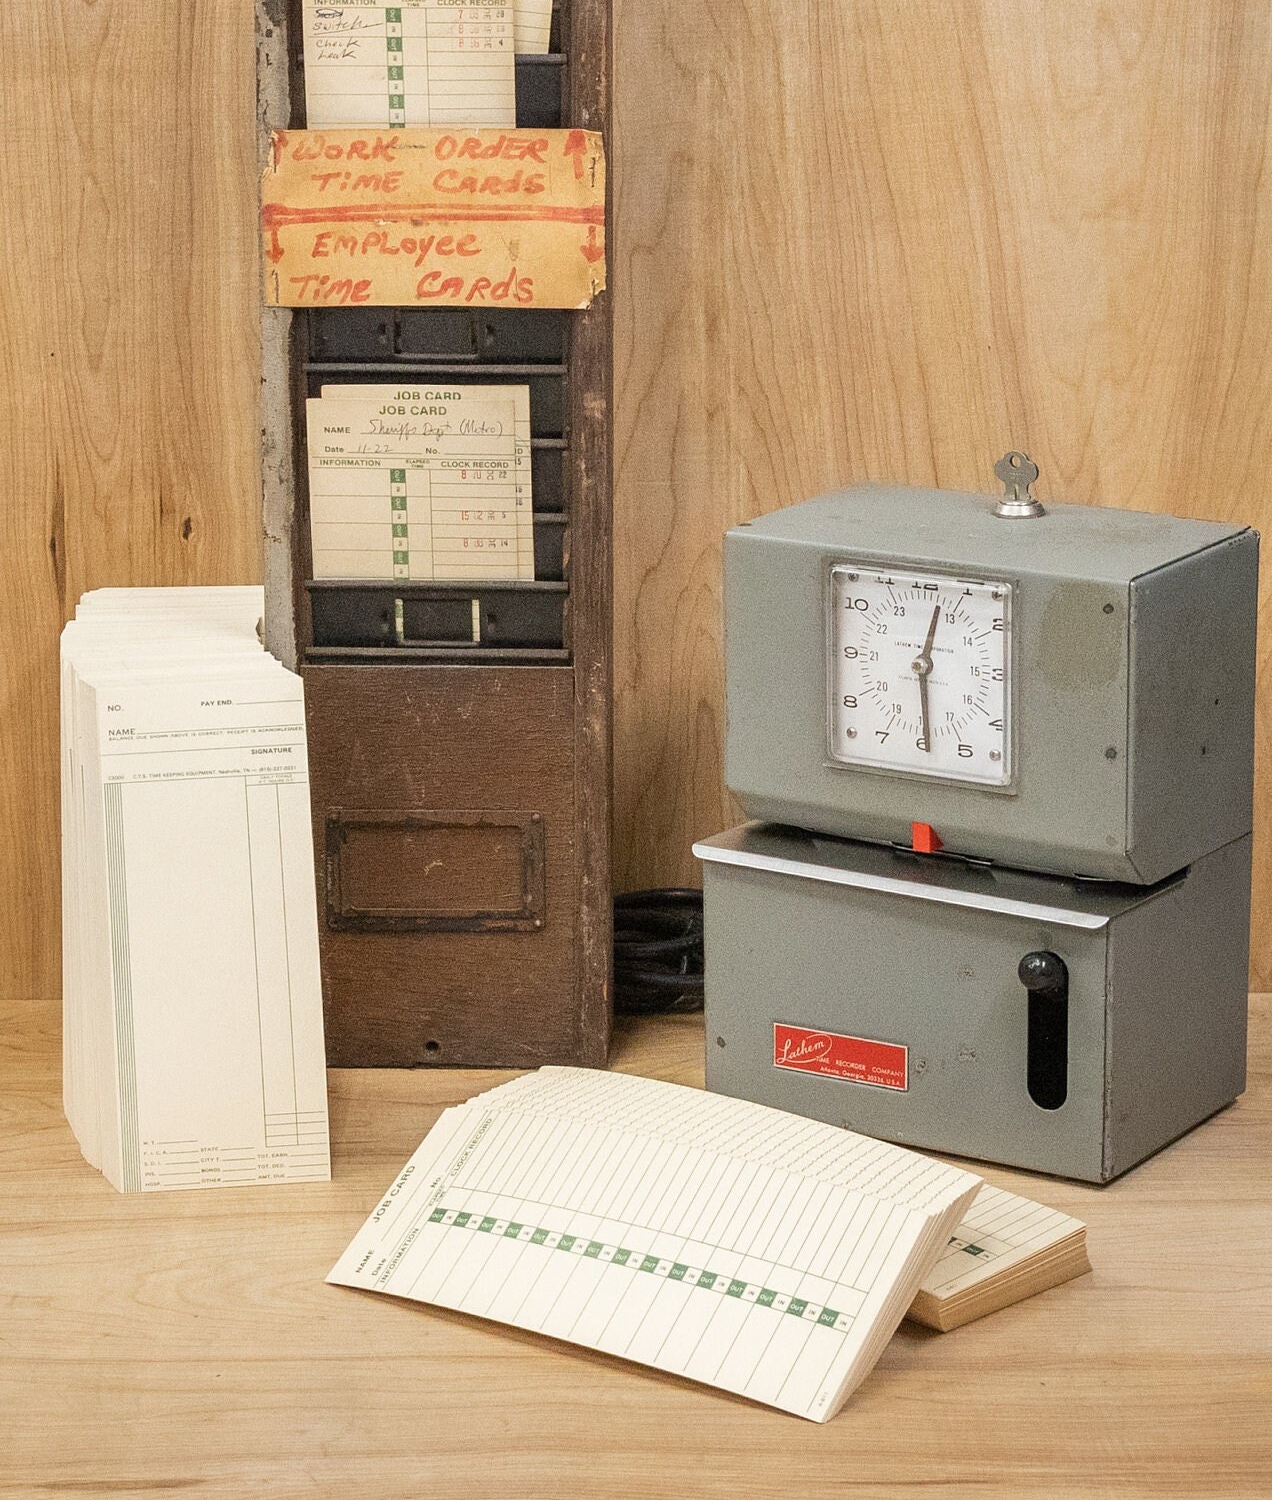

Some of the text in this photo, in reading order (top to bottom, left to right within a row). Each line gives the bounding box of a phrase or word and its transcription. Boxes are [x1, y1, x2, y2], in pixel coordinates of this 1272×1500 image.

[292, 136, 399, 162] WORK
[394, 392, 461, 400] JOB CARD
[379, 406, 447, 415] JOB CARD
[845, 597, 868, 611] 10
[894, 607, 905, 617] 23
[945, 614, 955, 624] 13
[877, 625, 888, 634] 22
[963, 636, 973, 647] 14
[845, 646, 858, 658] 9
[870, 651, 878, 660] 21
[970, 666, 980, 676] 15
[877, 681, 888, 691] 20
[844, 695, 858, 708] 8
[963, 695, 973, 705] 16
[892, 704, 901, 714] 19
[946, 712, 954, 721] 17
[875, 732, 889, 744] 7
[958, 745, 973, 757] 5
[777, 1039, 825, 1063] Lathem
[816, 1056, 904, 1078] TIME RECORDER COMPANY
[373, 1165, 415, 1223] JOB CARD
[380, 1118, 493, 1283] INFORMATION CLOCK RECORD
[356, 1249, 375, 1273] NAME
[372, 1258, 387, 1276] Date
[644, 1261, 656, 1269] OUT
[760, 1293, 773, 1302] OUT
[790, 1304, 803, 1312] OUT
[821, 1314, 835, 1322] OUT
